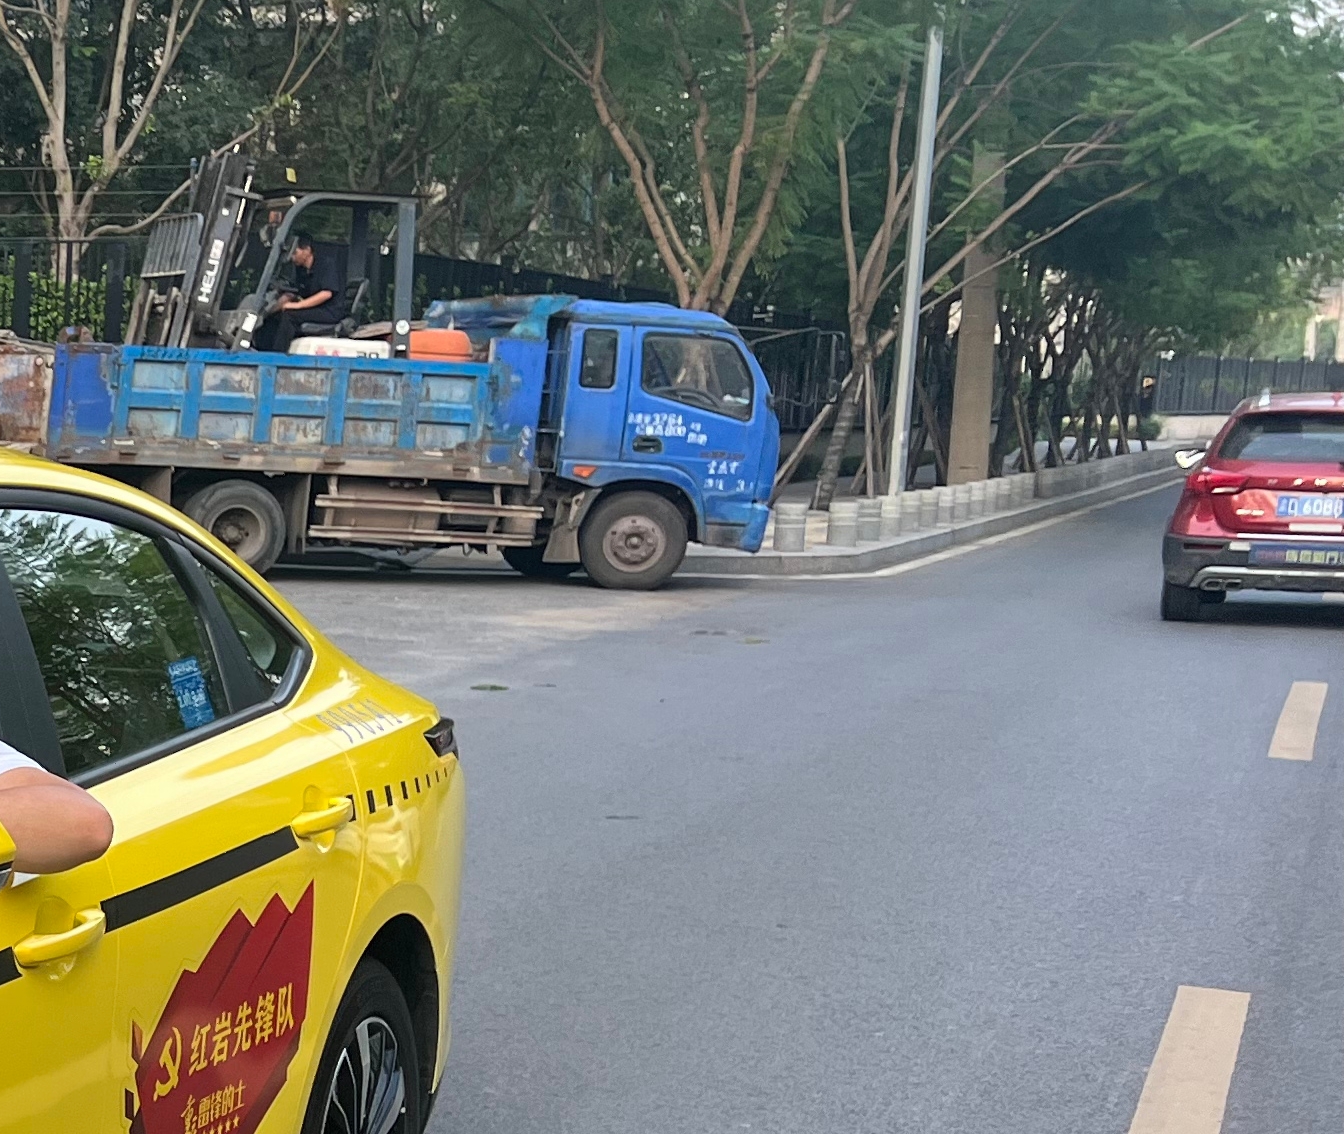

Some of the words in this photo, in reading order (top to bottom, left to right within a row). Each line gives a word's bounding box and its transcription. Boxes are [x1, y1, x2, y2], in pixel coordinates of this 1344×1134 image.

[188, 982, 294, 1077] 红岩先锋队
[198, 1079, 247, 1128] 雷锋的士
